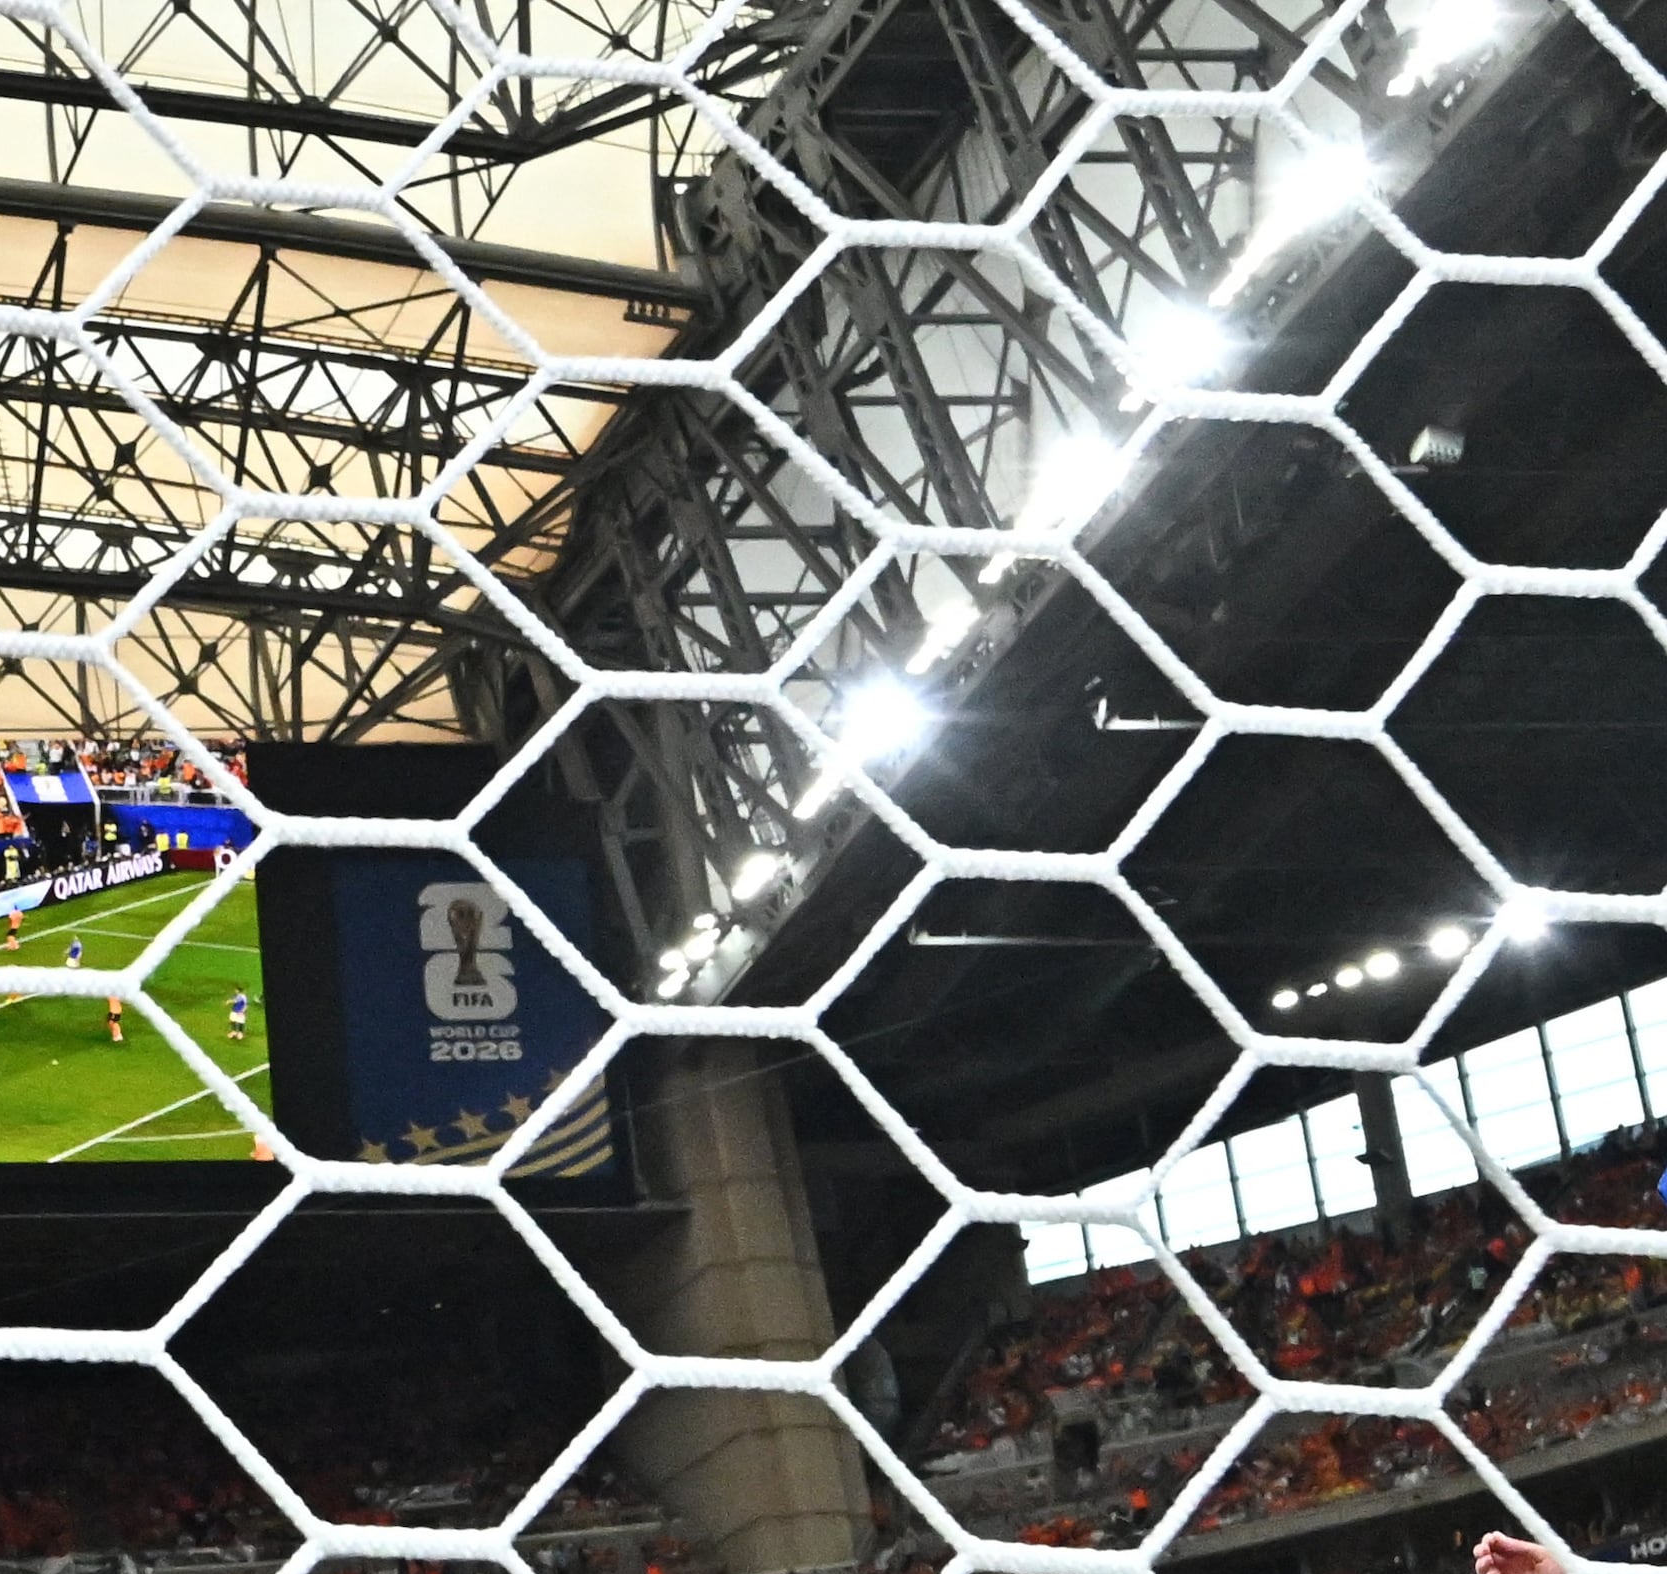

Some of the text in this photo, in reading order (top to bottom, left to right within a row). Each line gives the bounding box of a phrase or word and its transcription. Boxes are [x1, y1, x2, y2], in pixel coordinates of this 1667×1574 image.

[54, 851, 163, 900] QATAR AIRWAYS
[452, 992, 494, 1008] FIFA
[429, 1025, 521, 1039] WORLD CUP
[430, 1041, 523, 1062] 2026
